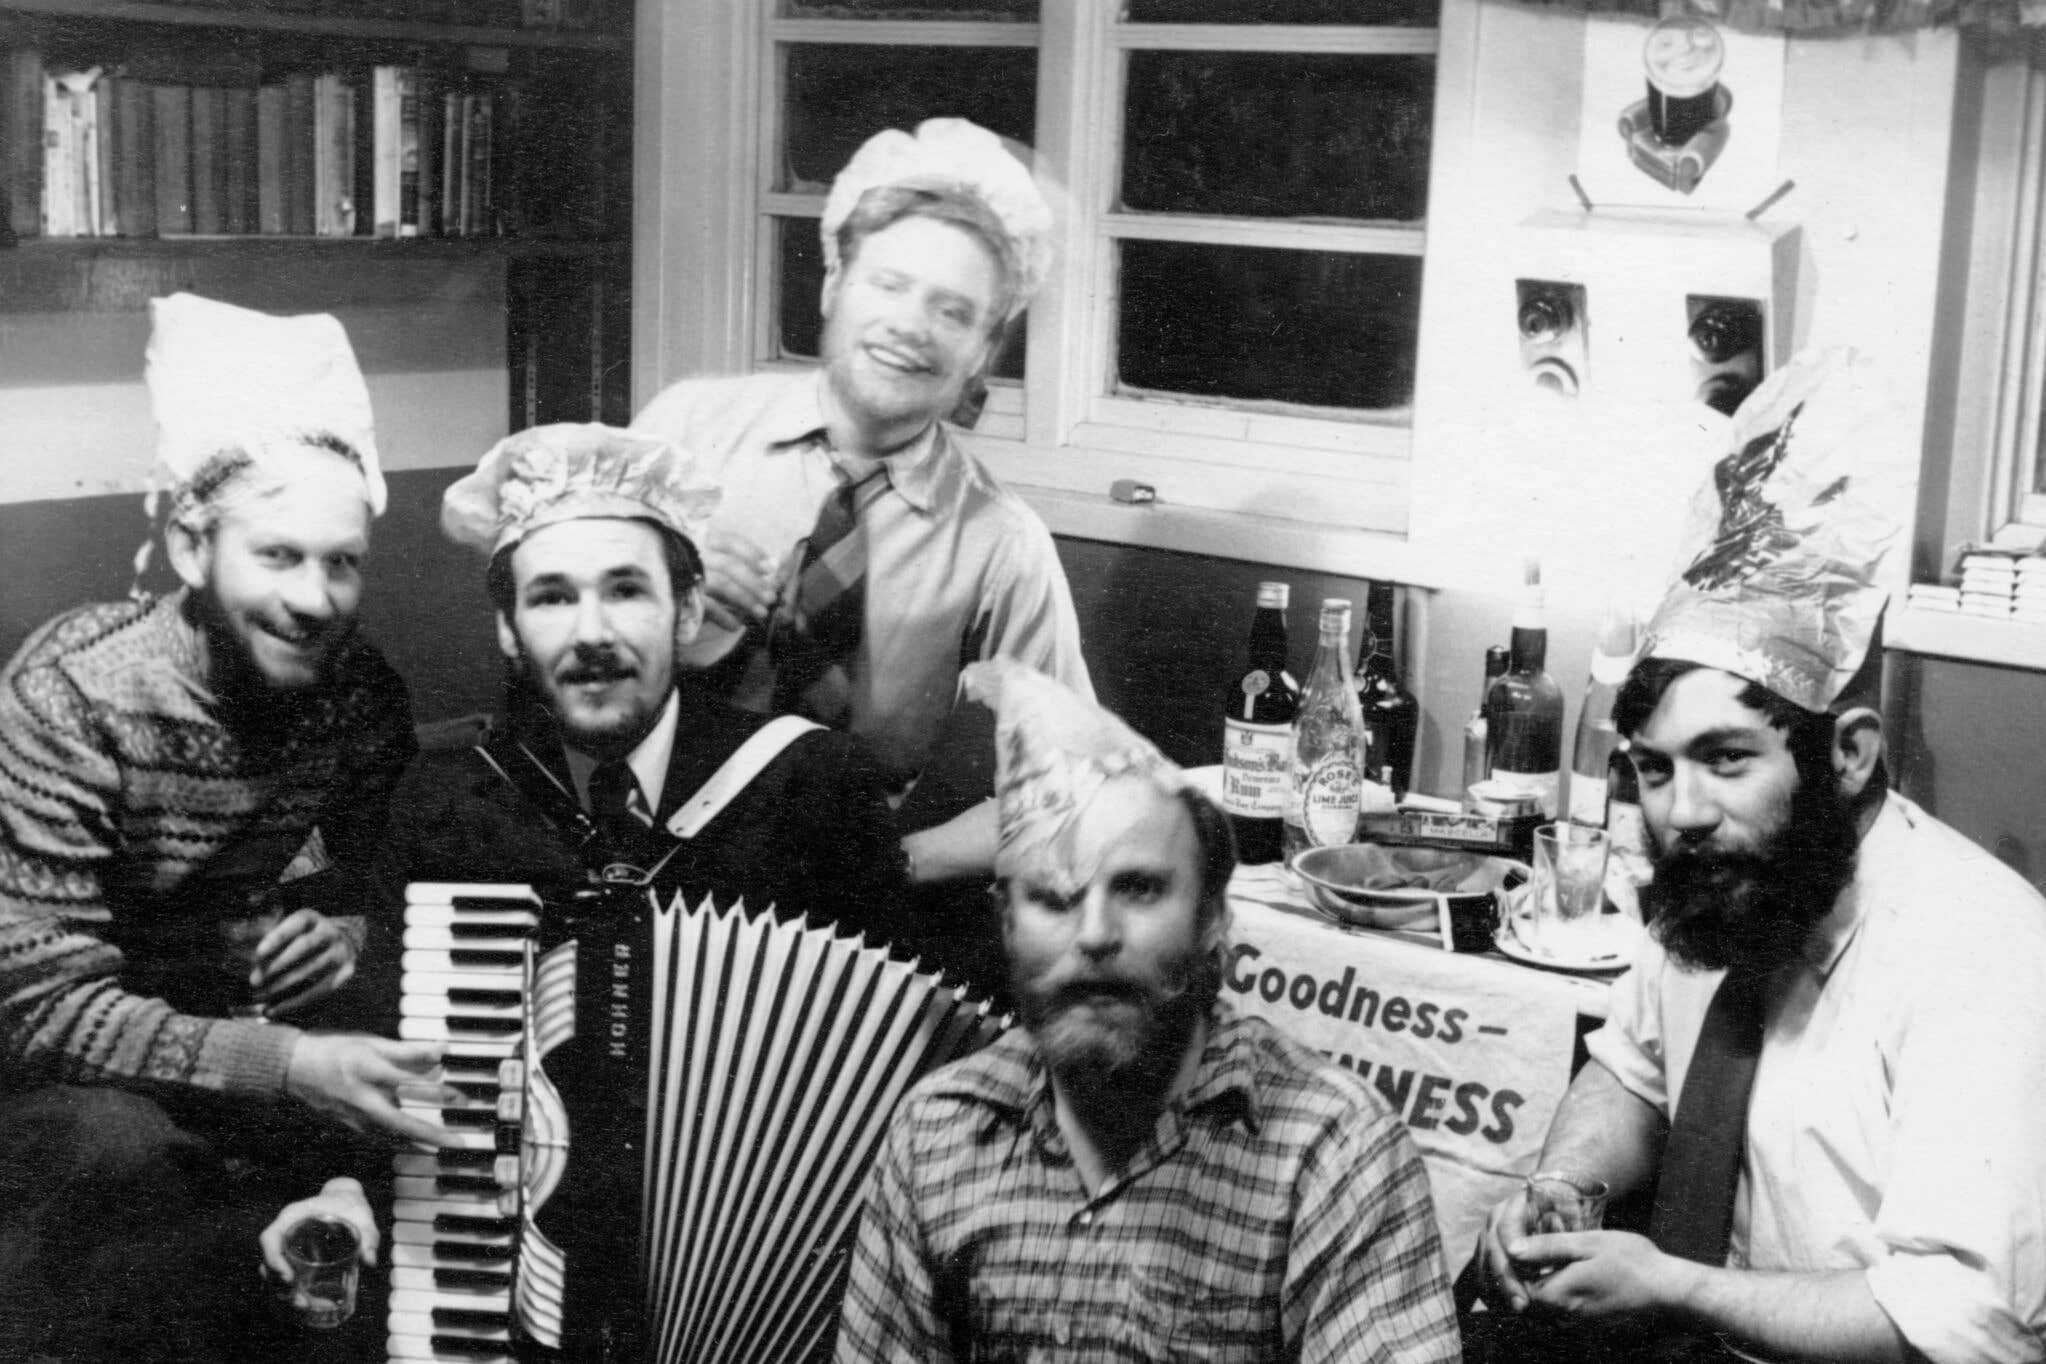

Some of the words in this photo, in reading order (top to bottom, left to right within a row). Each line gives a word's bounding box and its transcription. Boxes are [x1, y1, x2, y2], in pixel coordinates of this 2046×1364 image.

[1229, 775, 1261, 798] Rum
[609, 943, 631, 1056] HOHNER
[1225, 943, 1469, 1044] Goodness
[1319, 1050, 1525, 1144] NESS
